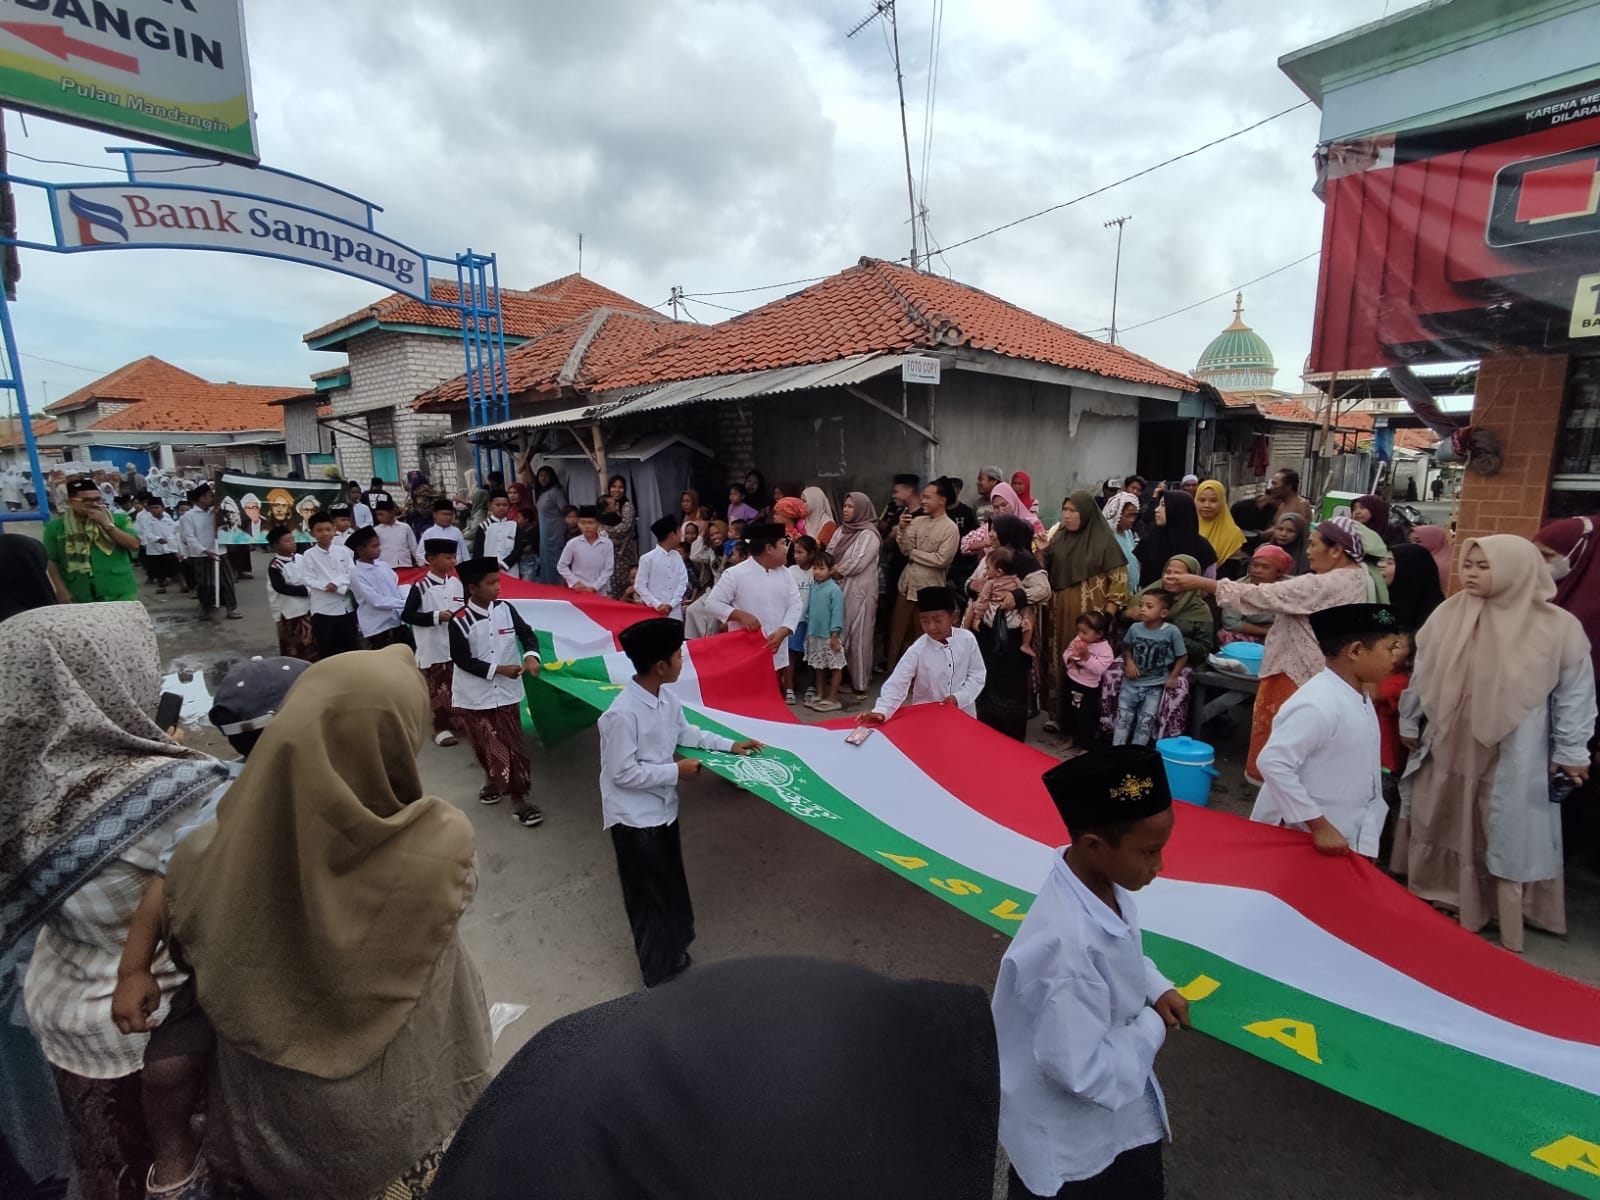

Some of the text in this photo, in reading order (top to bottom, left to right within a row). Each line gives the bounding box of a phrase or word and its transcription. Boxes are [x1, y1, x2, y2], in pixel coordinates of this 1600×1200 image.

[15, 0, 224, 70] ANGIN
[60, 76, 230, 135] Pulau Mandangin
[1526, 100, 1577, 120] KARENA
[1551, 105, 1600, 125] DILARA
[122, 194, 416, 284] Bank Sampang
[907, 359, 938, 374] FOTO COPY
